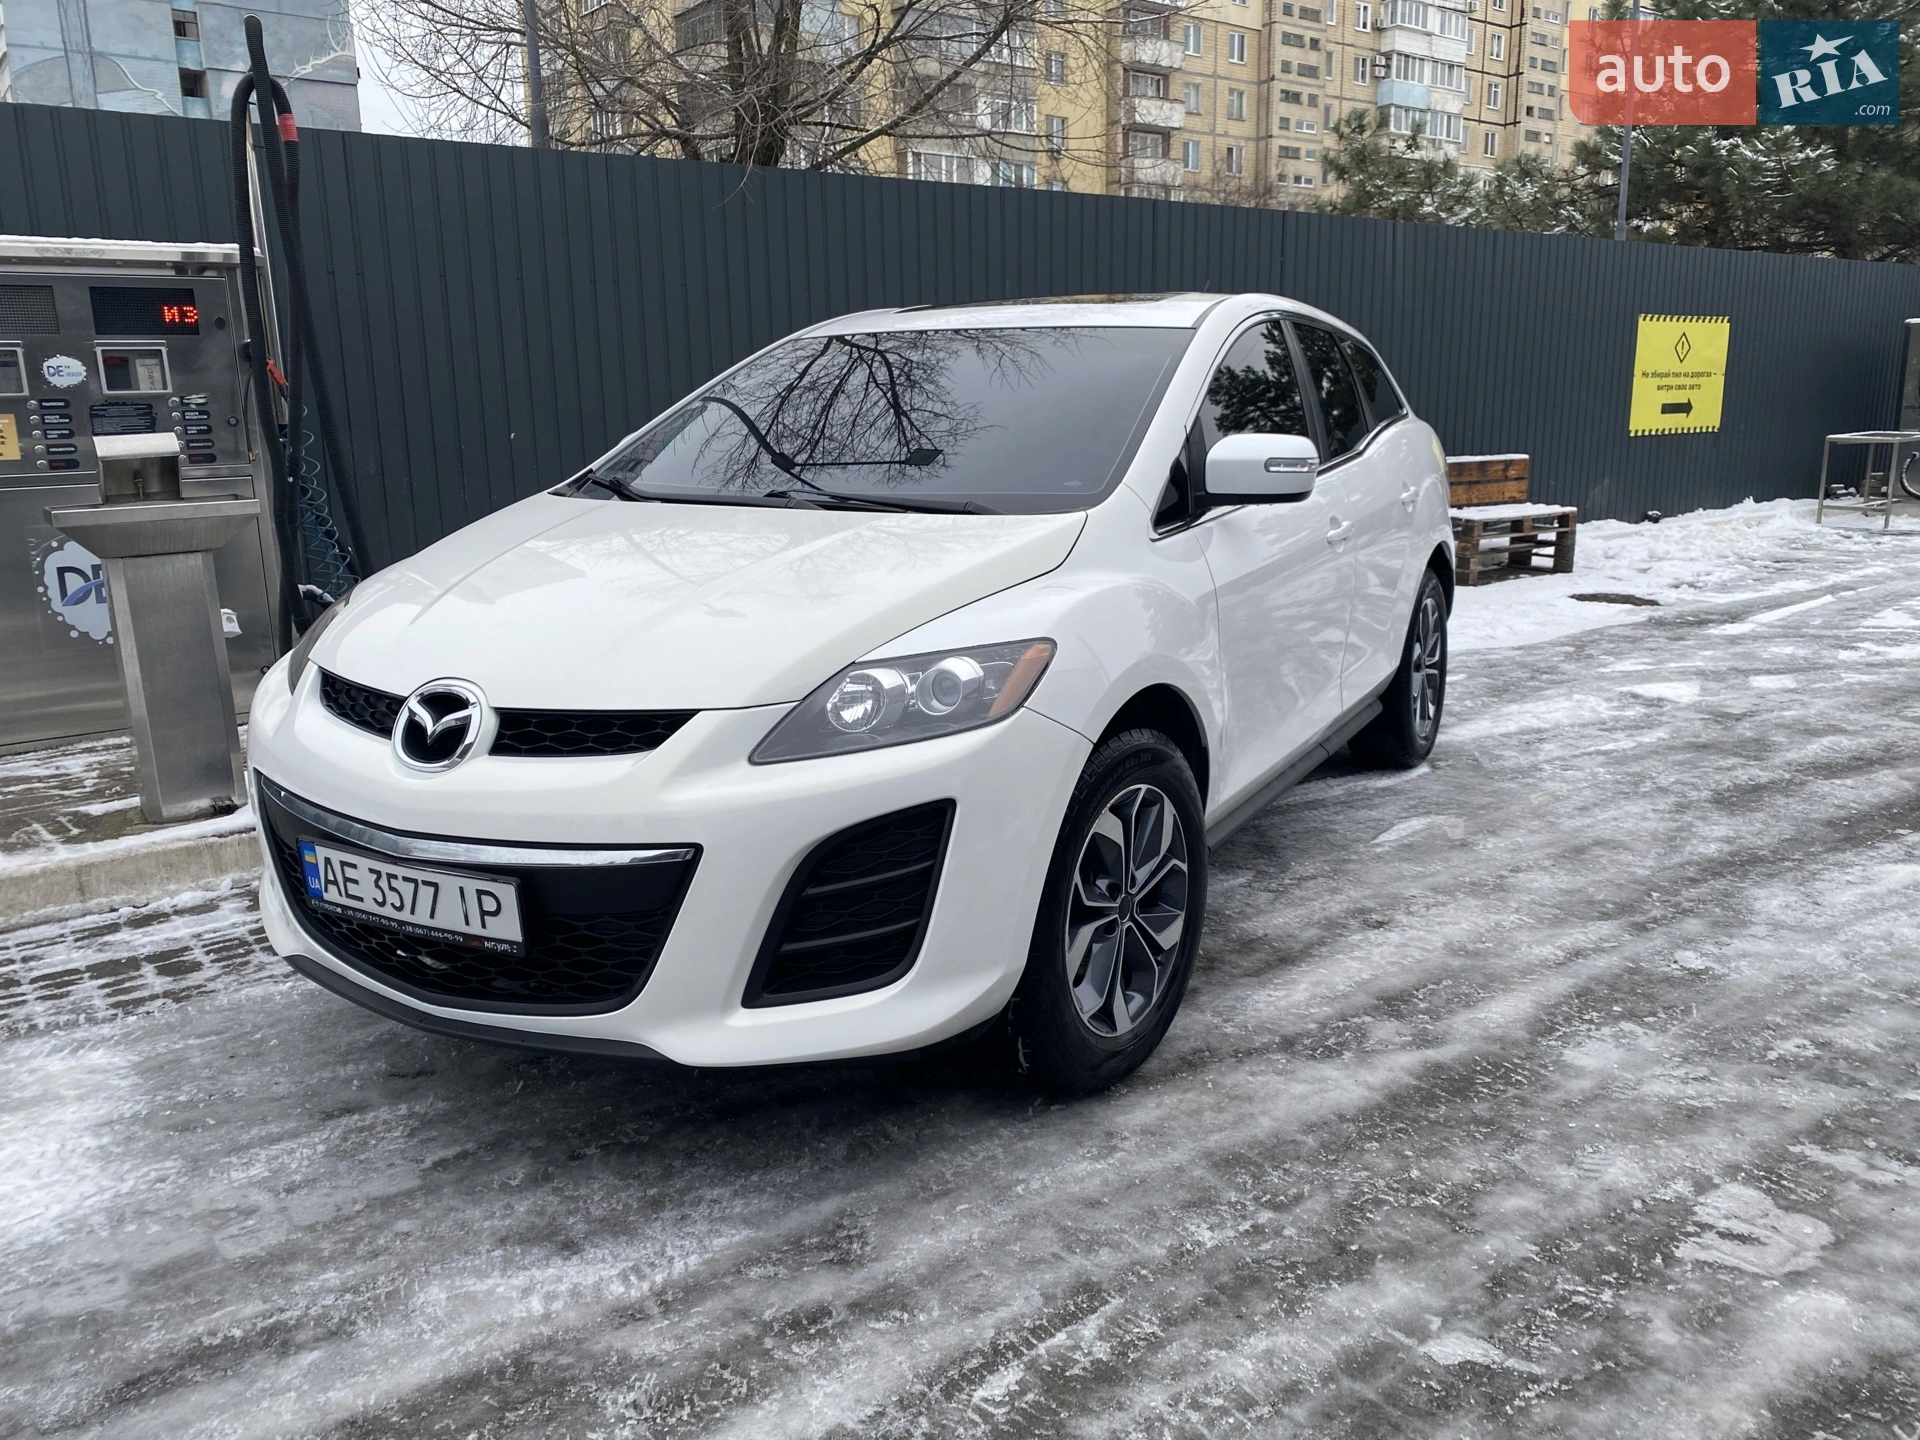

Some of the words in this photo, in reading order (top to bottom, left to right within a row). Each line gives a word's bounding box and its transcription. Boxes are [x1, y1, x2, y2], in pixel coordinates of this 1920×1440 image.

[47, 365, 64, 377] DE
[1641, 370, 1649, 378] Не
[1690, 371, 1712, 379] дорогах
[308, 876, 322, 890] UA
[323, 856, 364, 903] AE
[368, 867, 439, 920] 3577
[458, 885, 502, 930] IP
